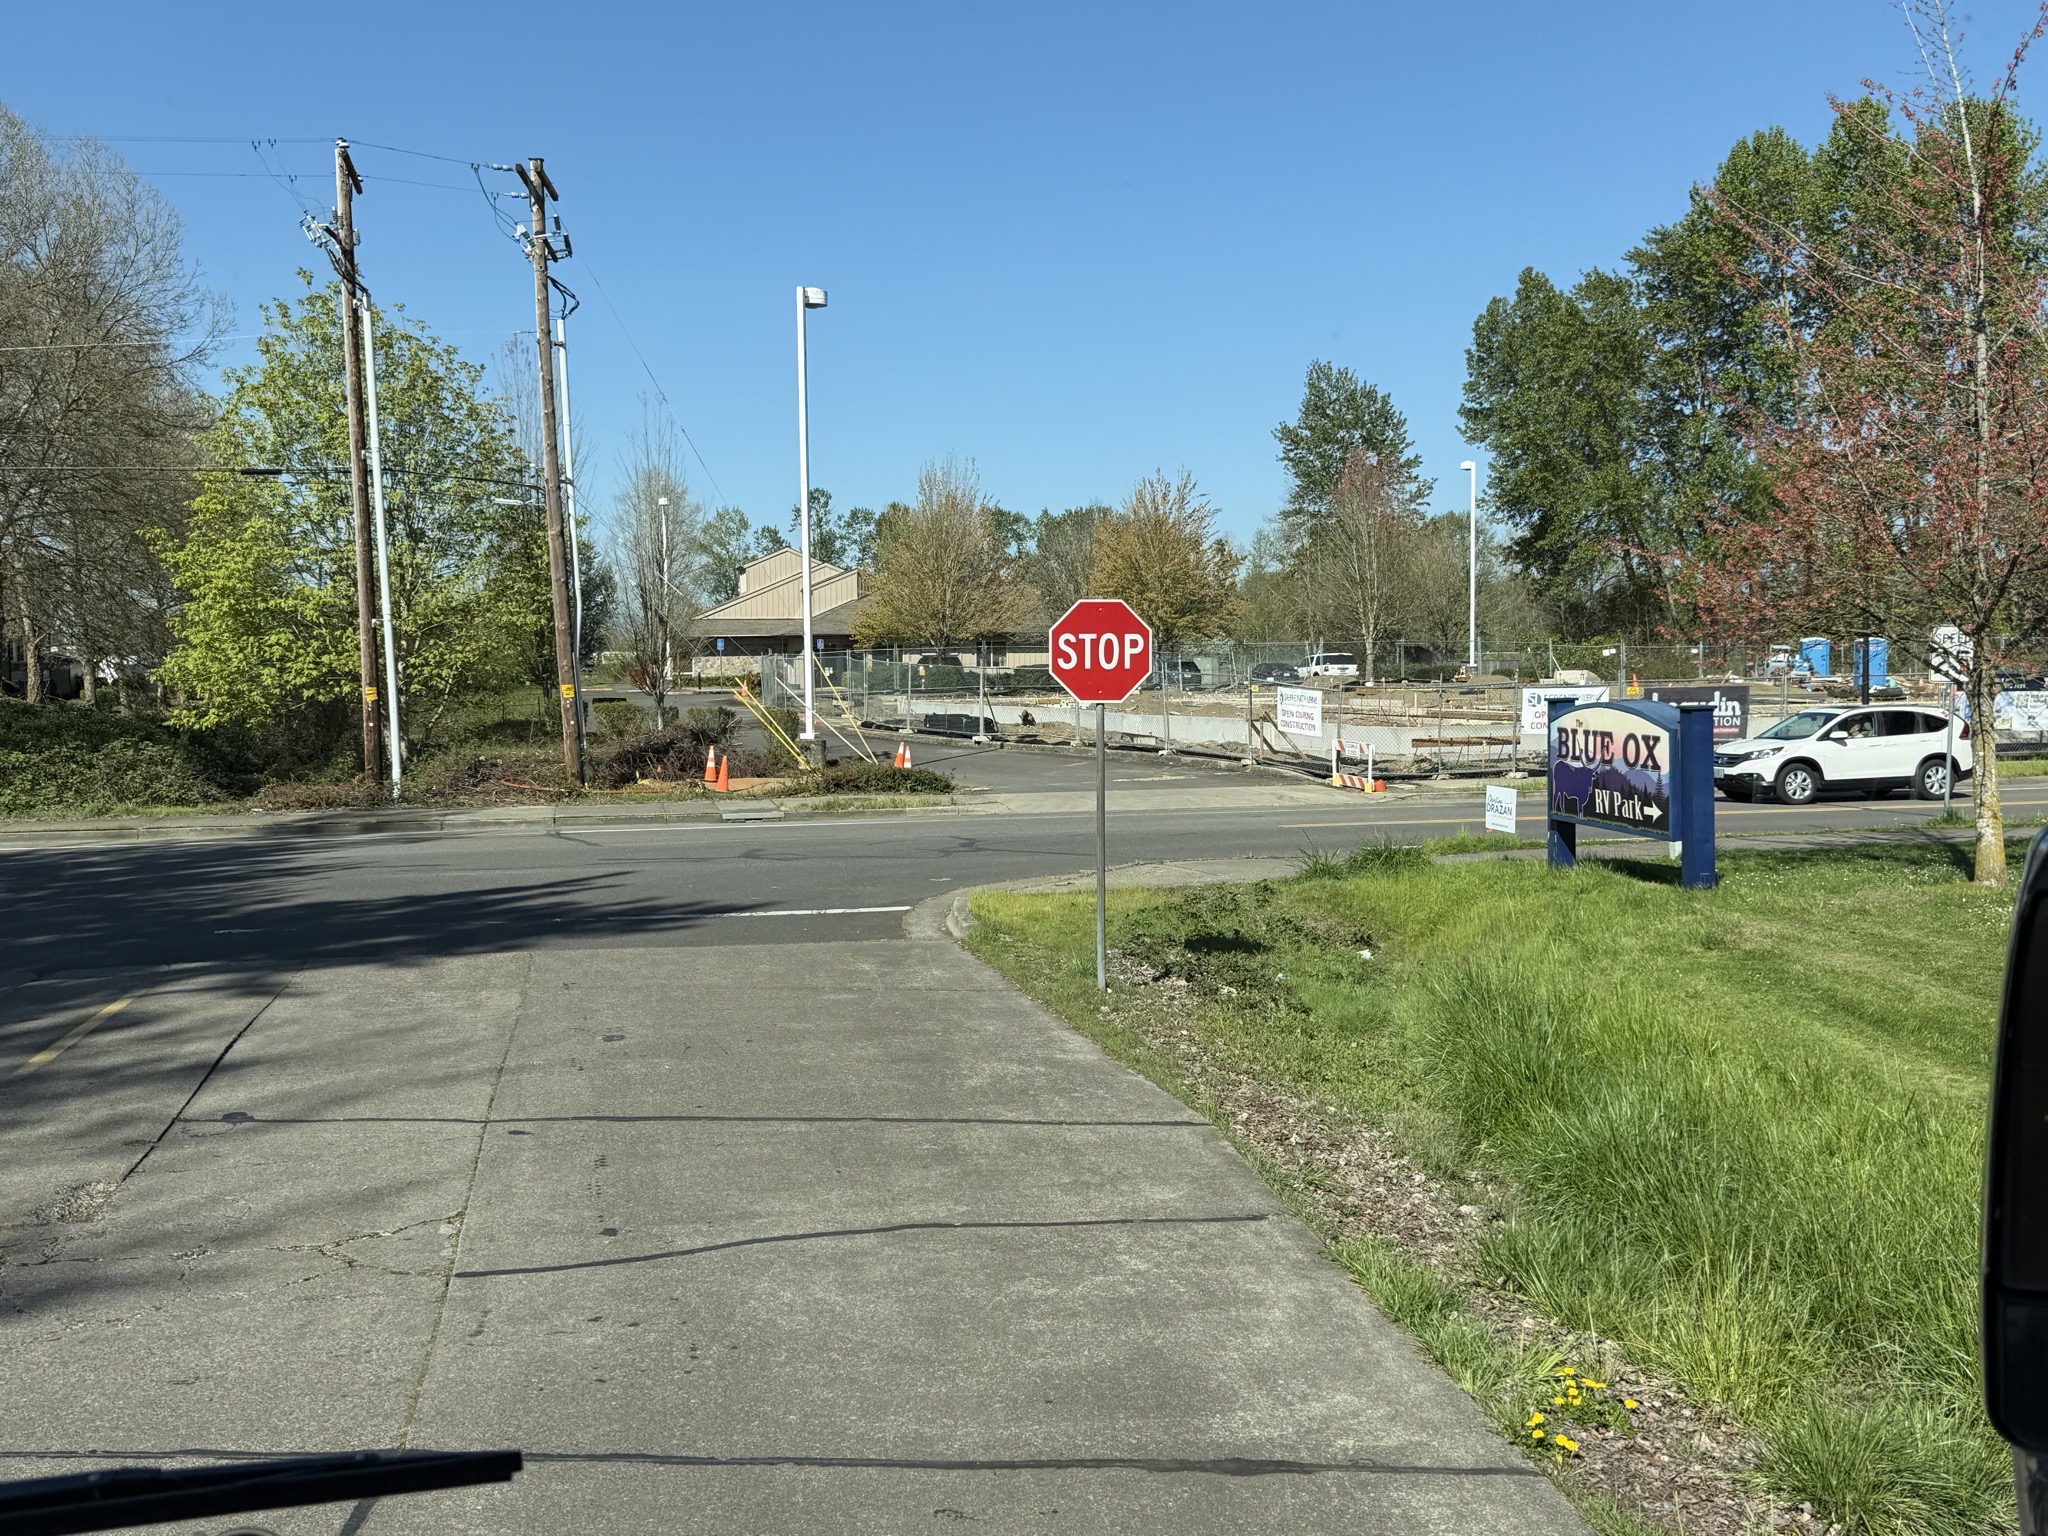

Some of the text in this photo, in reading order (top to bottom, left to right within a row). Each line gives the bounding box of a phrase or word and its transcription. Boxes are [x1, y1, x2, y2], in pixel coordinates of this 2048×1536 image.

[1936, 634, 1971, 644] SPEED
[1057, 633, 1144, 670] STOP
[1534, 711, 1547, 719] OP
[1280, 720, 1316, 732] CONSTRUCTION
[1575, 719, 1583, 728] The
[1556, 727, 1661, 771] BLUE OX
[1486, 803, 1513, 816] DRAZAN
[1594, 788, 1643, 820] RV Park
